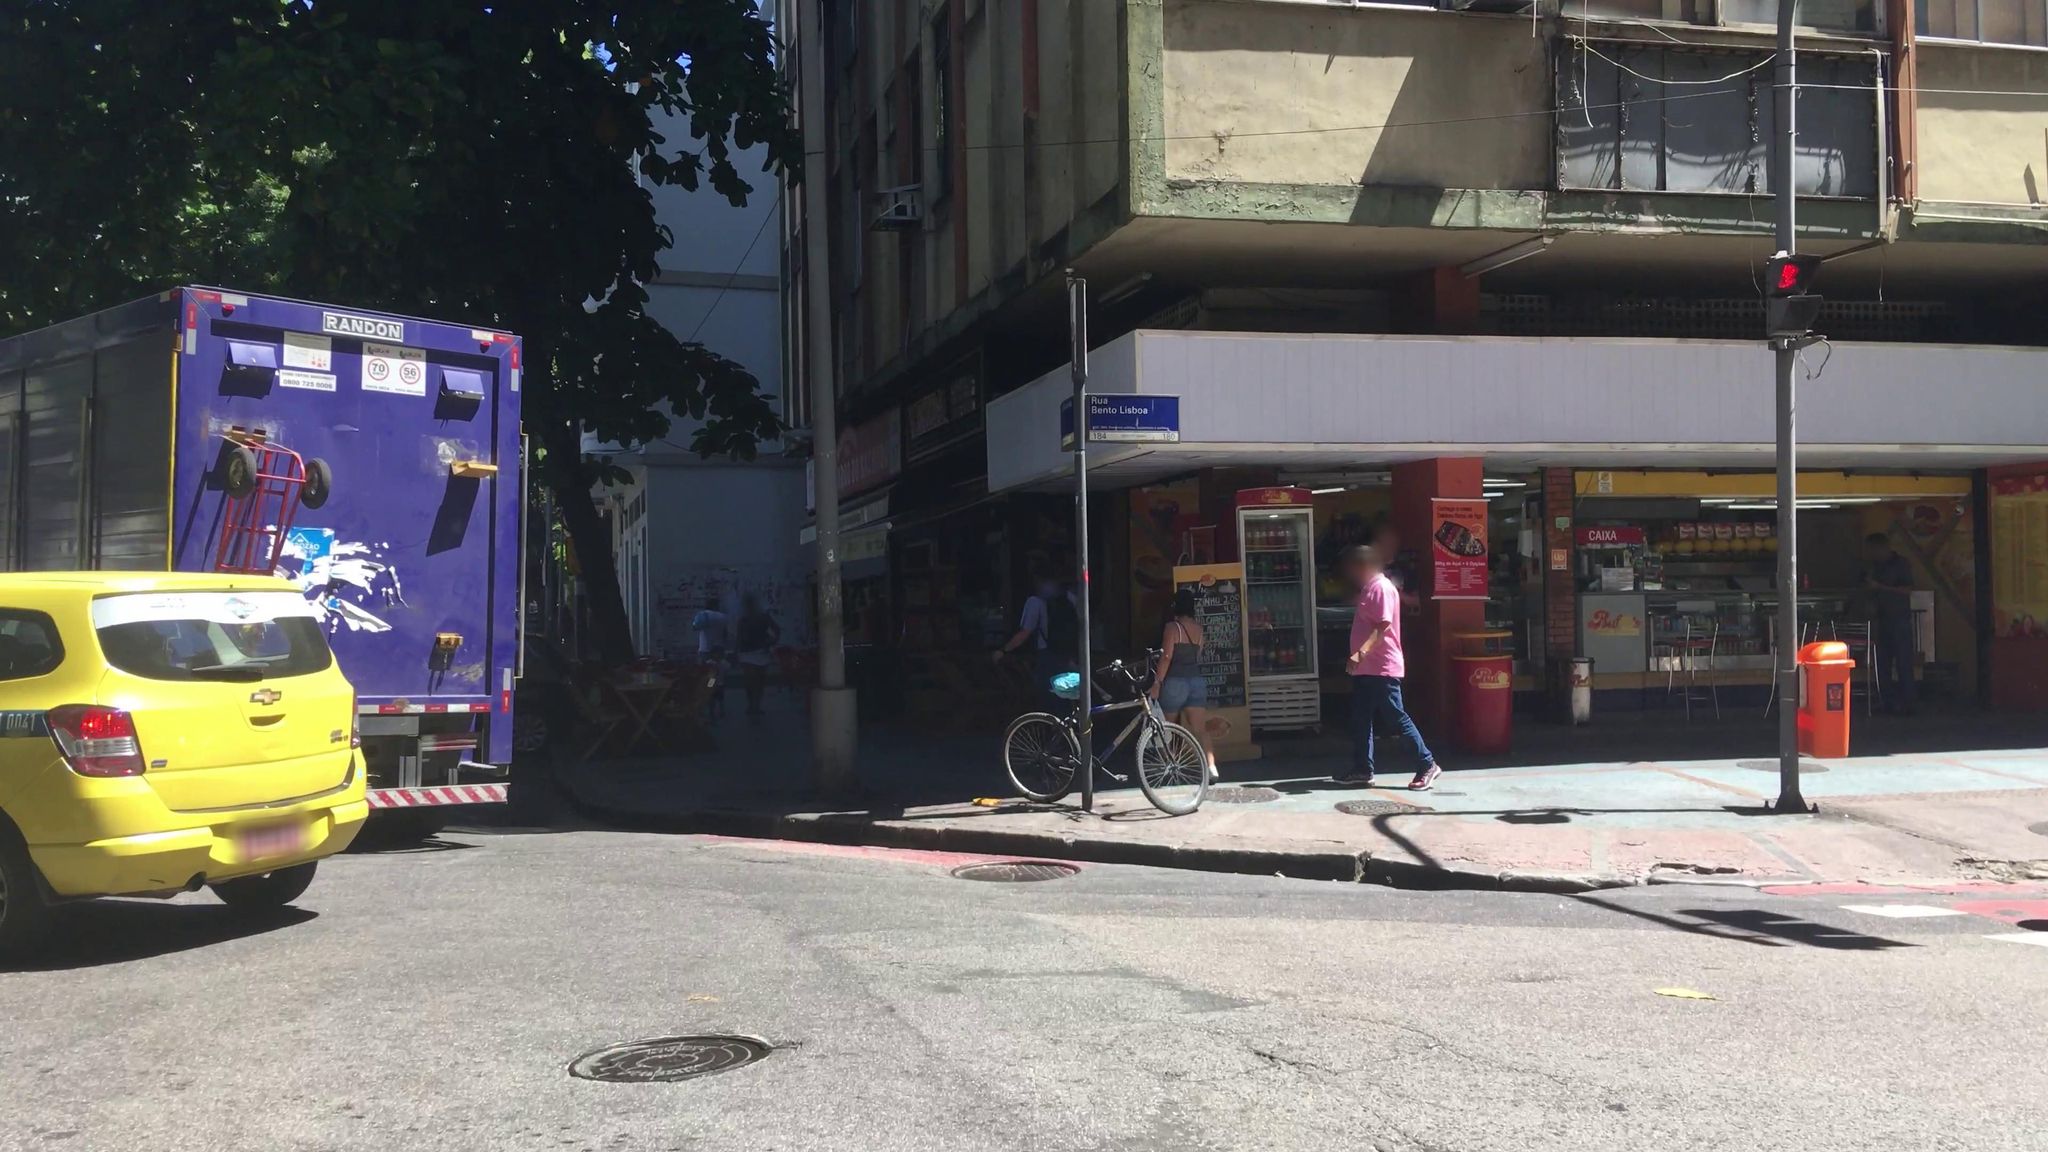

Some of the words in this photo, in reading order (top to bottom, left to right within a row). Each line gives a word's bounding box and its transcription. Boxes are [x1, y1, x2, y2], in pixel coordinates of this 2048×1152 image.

[326, 315, 401, 338] RANDON
[372, 363, 385, 373] 70
[403, 367, 417, 377] 56
[1091, 397, 1108, 405] Rua
[1091, 406, 1117, 414] Bento
[1120, 406, 1148, 415] Lisboa
[1588, 530, 1617, 541] CAIXA
